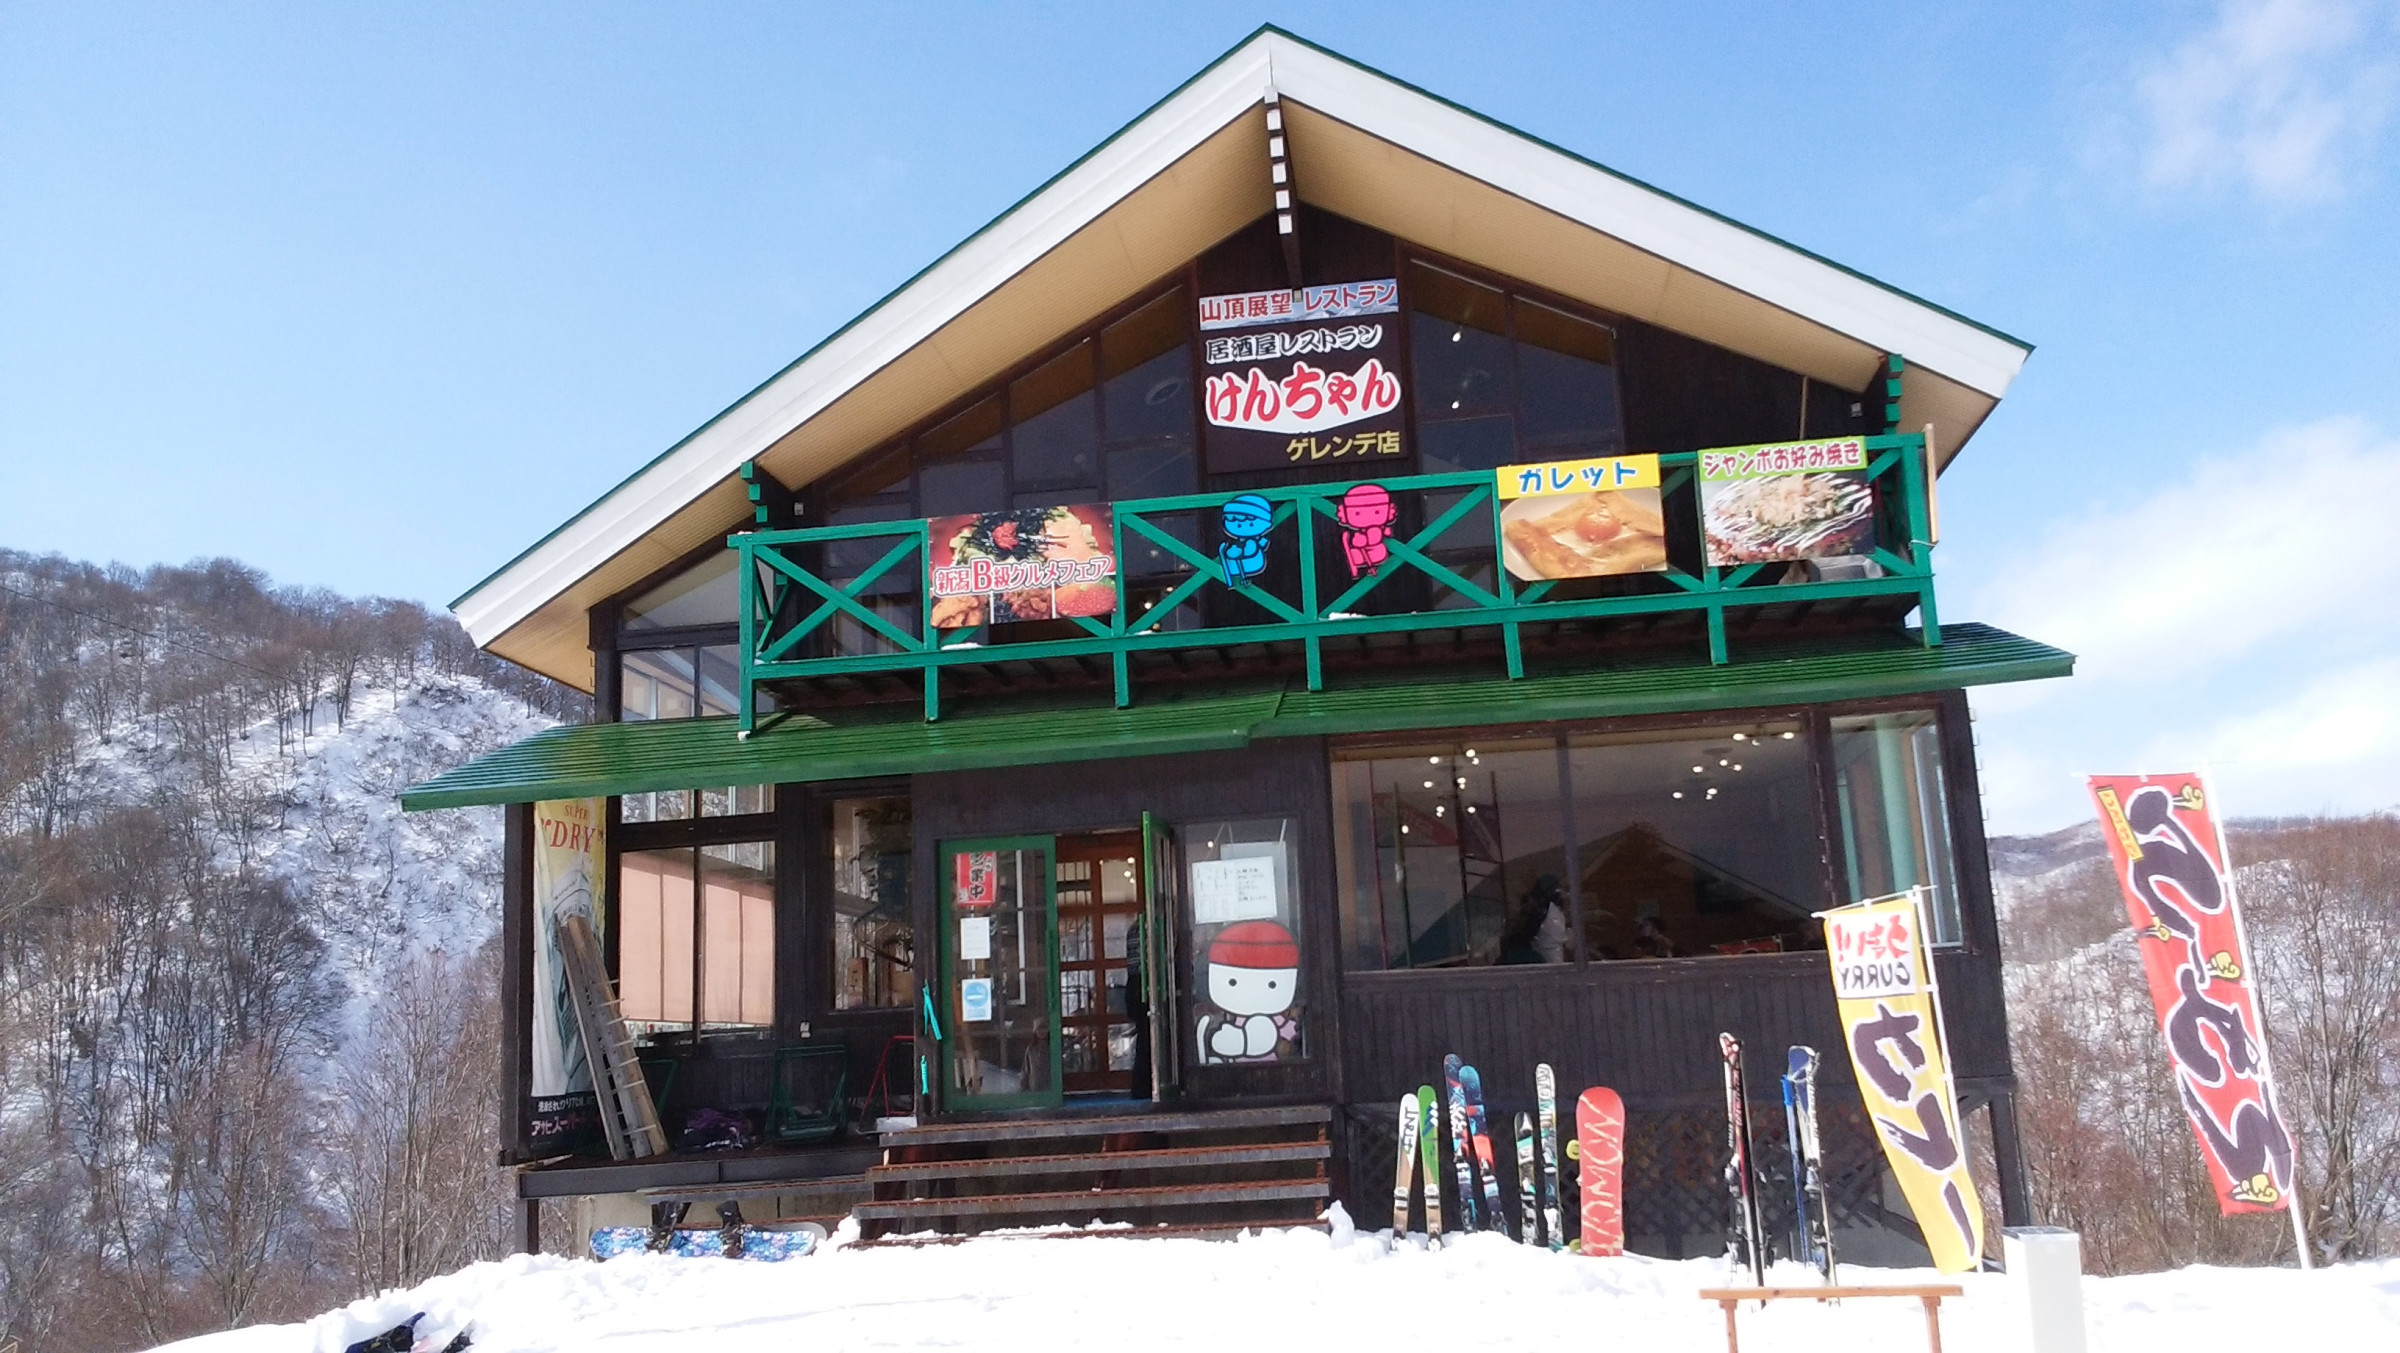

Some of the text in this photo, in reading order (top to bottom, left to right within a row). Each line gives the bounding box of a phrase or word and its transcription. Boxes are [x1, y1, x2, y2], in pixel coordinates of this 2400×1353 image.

[1200, 284, 1396, 322] 山頂展望 レストラン
[1207, 325, 1382, 363] 居酒屋レストラン
[1208, 361, 1397, 423] けんちゃん
[1518, 461, 1638, 494] ガレット
[934, 556, 1111, 597] 新潟B級グルメフェア
[564, 804, 591, 821] SUPER
